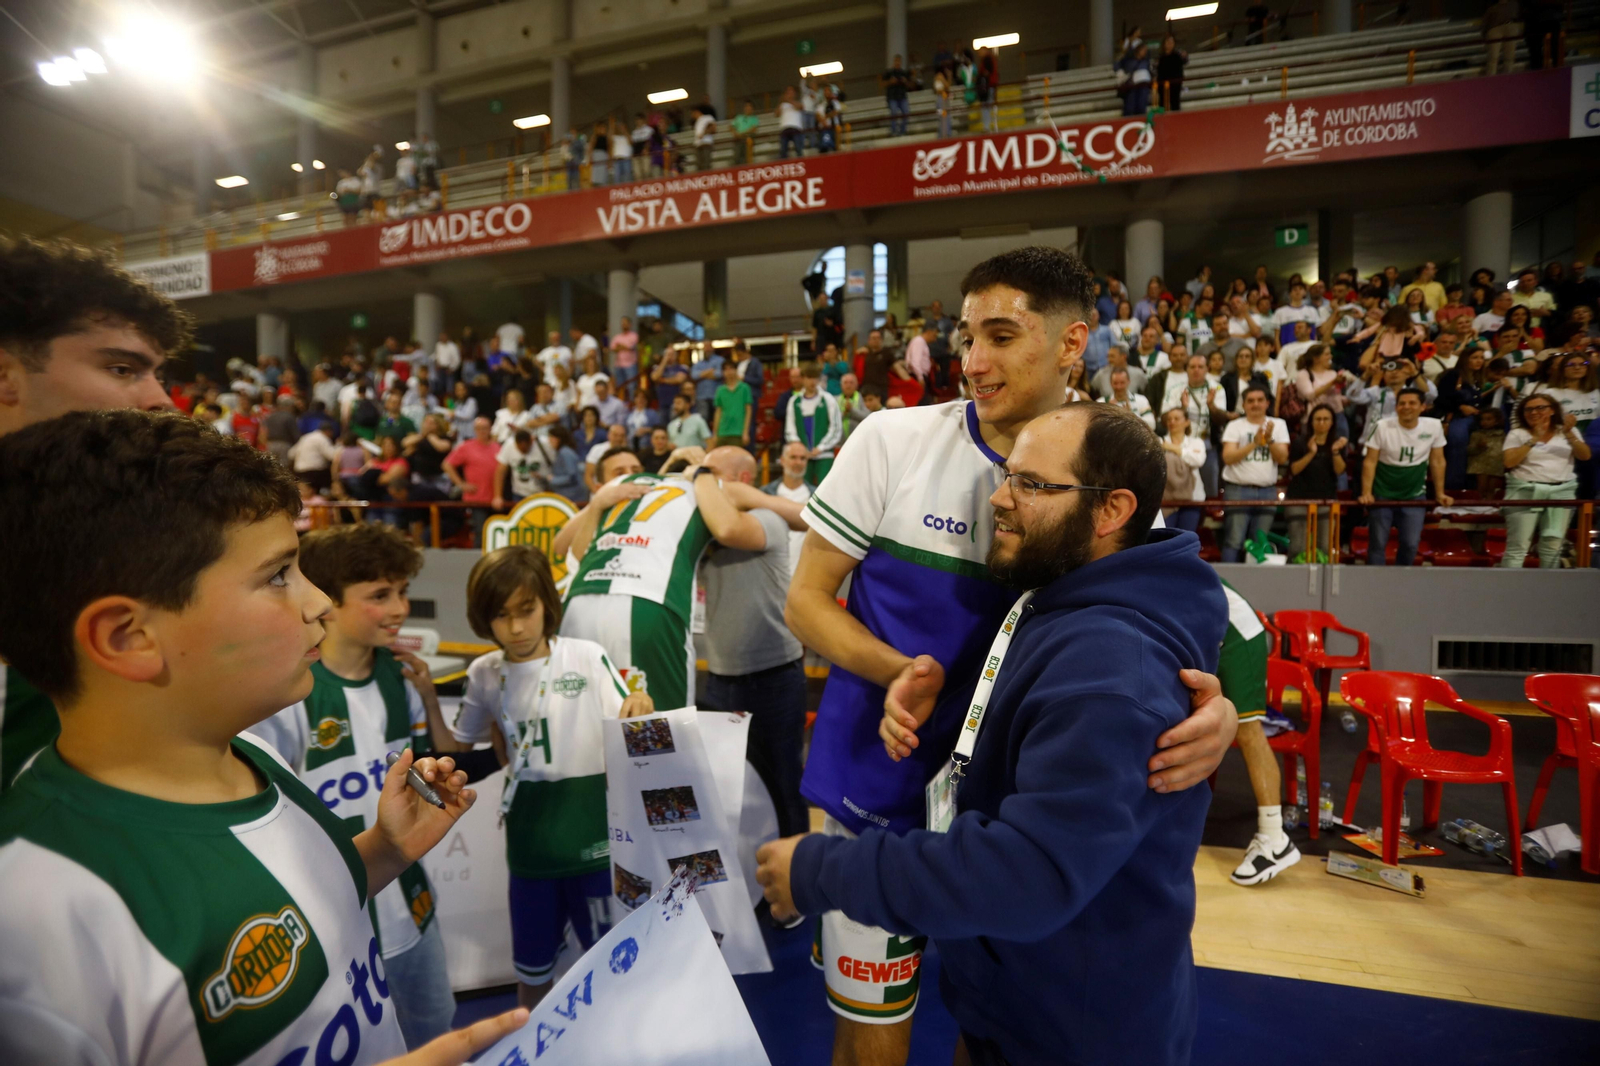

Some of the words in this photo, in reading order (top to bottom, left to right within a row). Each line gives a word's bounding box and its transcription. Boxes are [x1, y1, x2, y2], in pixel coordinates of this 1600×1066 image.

[1323, 98, 1436, 127] AYUNTAMIENTO
[966, 121, 1156, 175] IMDECO
[1323, 129, 1341, 148] DE
[610, 182, 664, 202] PALACIO
[665, 173, 735, 194] MUNICIPAL
[738, 162, 806, 185] DEPORTES
[913, 179, 961, 198] Instituto
[962, 175, 1021, 194] Municipal
[1022, 174, 1039, 187] de
[597, 197, 683, 235] VISTA
[692, 177, 827, 222] ALEGRE
[411, 202, 532, 248] IMDECO
[1285, 228, 1299, 244] D
[1399, 446, 1414, 463] 14
[922, 513, 968, 535] coto
[989, 655, 1001, 670] CCB
[970, 704, 983, 720] CCB
[316, 758, 391, 810] cot
